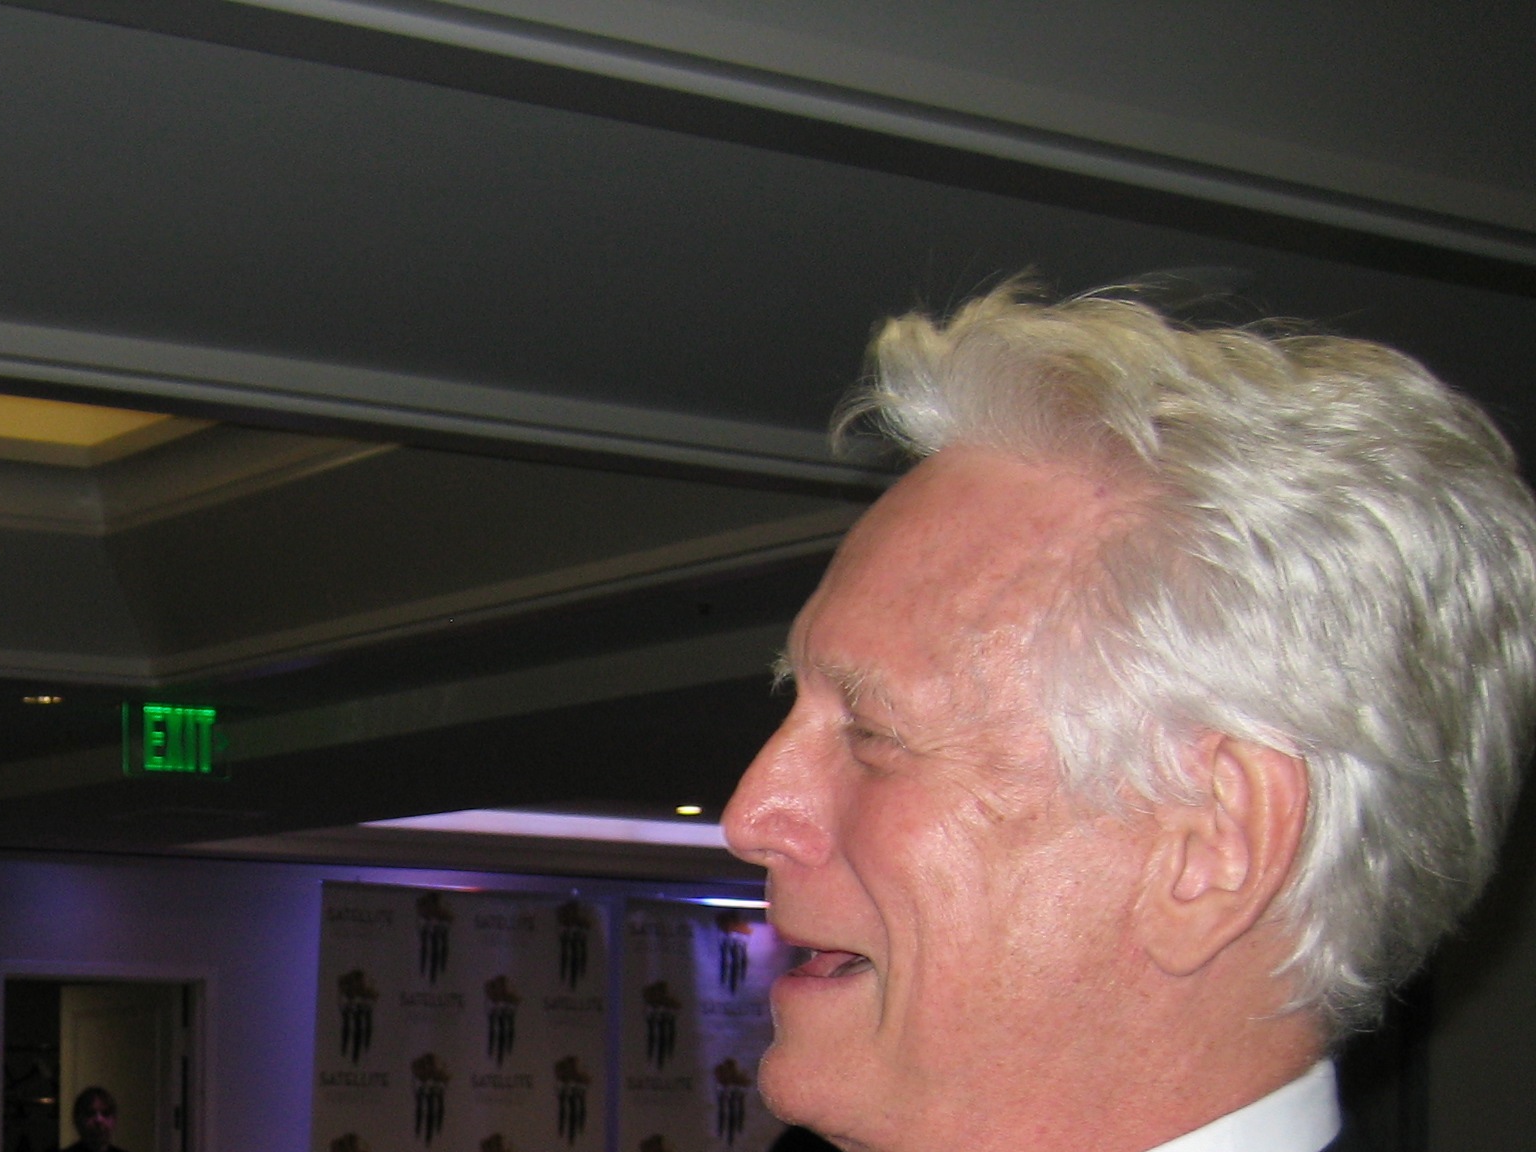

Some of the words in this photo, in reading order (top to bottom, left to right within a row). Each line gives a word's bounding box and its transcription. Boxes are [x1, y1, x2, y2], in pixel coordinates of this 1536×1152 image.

[143, 705, 216, 773] EXIT
[319, 1070, 390, 1087] SATELLITE
[471, 1072, 534, 1089] SATELLITE
